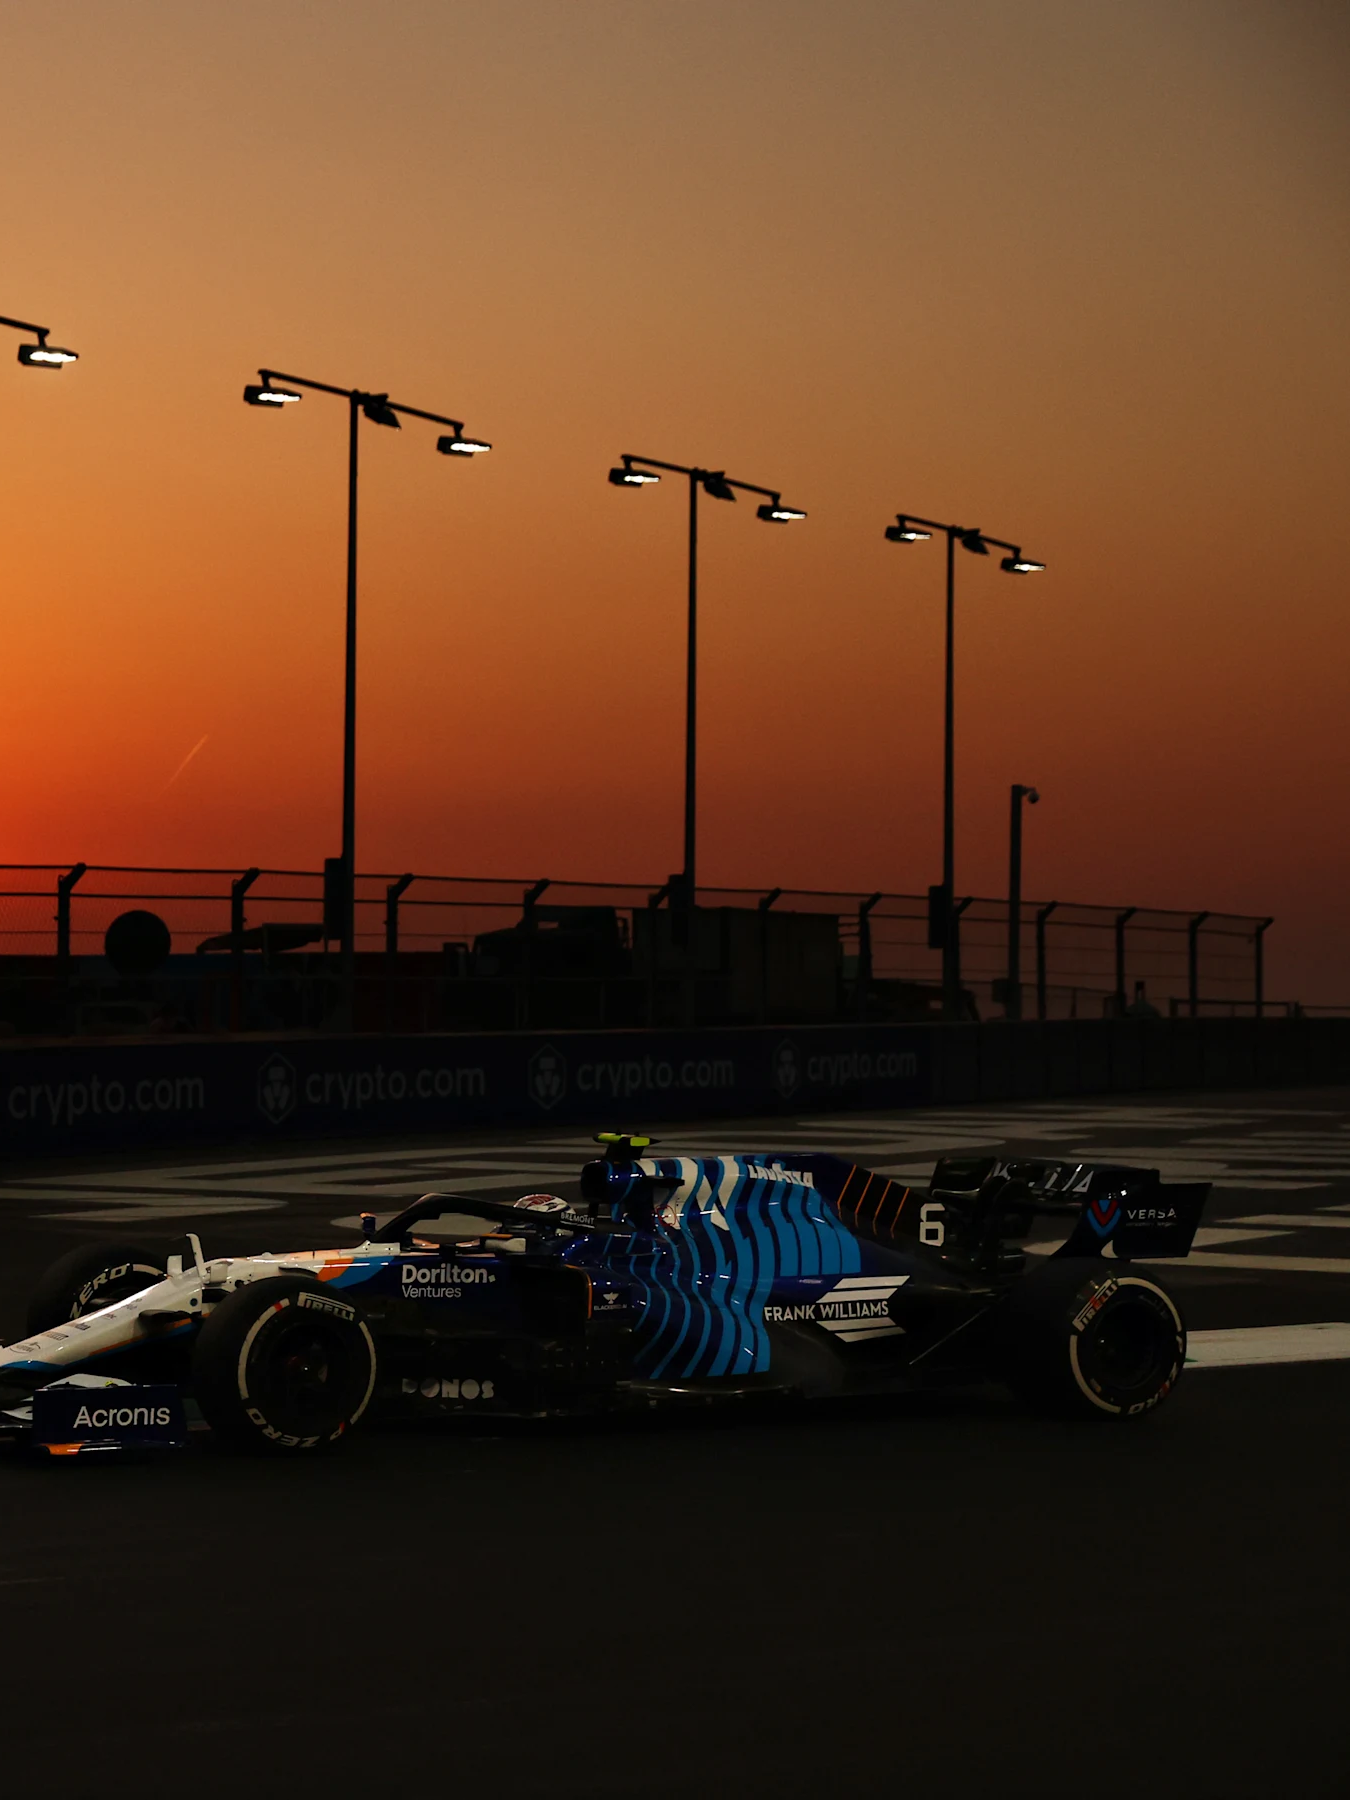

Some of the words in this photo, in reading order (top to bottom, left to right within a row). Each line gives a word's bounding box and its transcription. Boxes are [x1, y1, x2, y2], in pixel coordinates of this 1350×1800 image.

[577, 1054, 735, 1097] crypto.com
[807, 1048, 918, 1086] crypto.com
[7, 1072, 205, 1127] crypto.com
[305, 1064, 486, 1110] crypto.com
[560, 1211, 595, 1225] BREMONT
[919, 1203, 946, 1247] 6
[1126, 1207, 1177, 1220] VERSA
[296, 1291, 356, 1322] PIRELLI
[401, 1285, 462, 1298] Ventures
[1071, 1278, 1119, 1332] PIRELLI
[763, 1304, 816, 1322] FRANK
[819, 1300, 890, 1319] WILLIAMS
[72, 1405, 171, 1428] Acronis
[245, 1407, 321, 1448] ZERO
